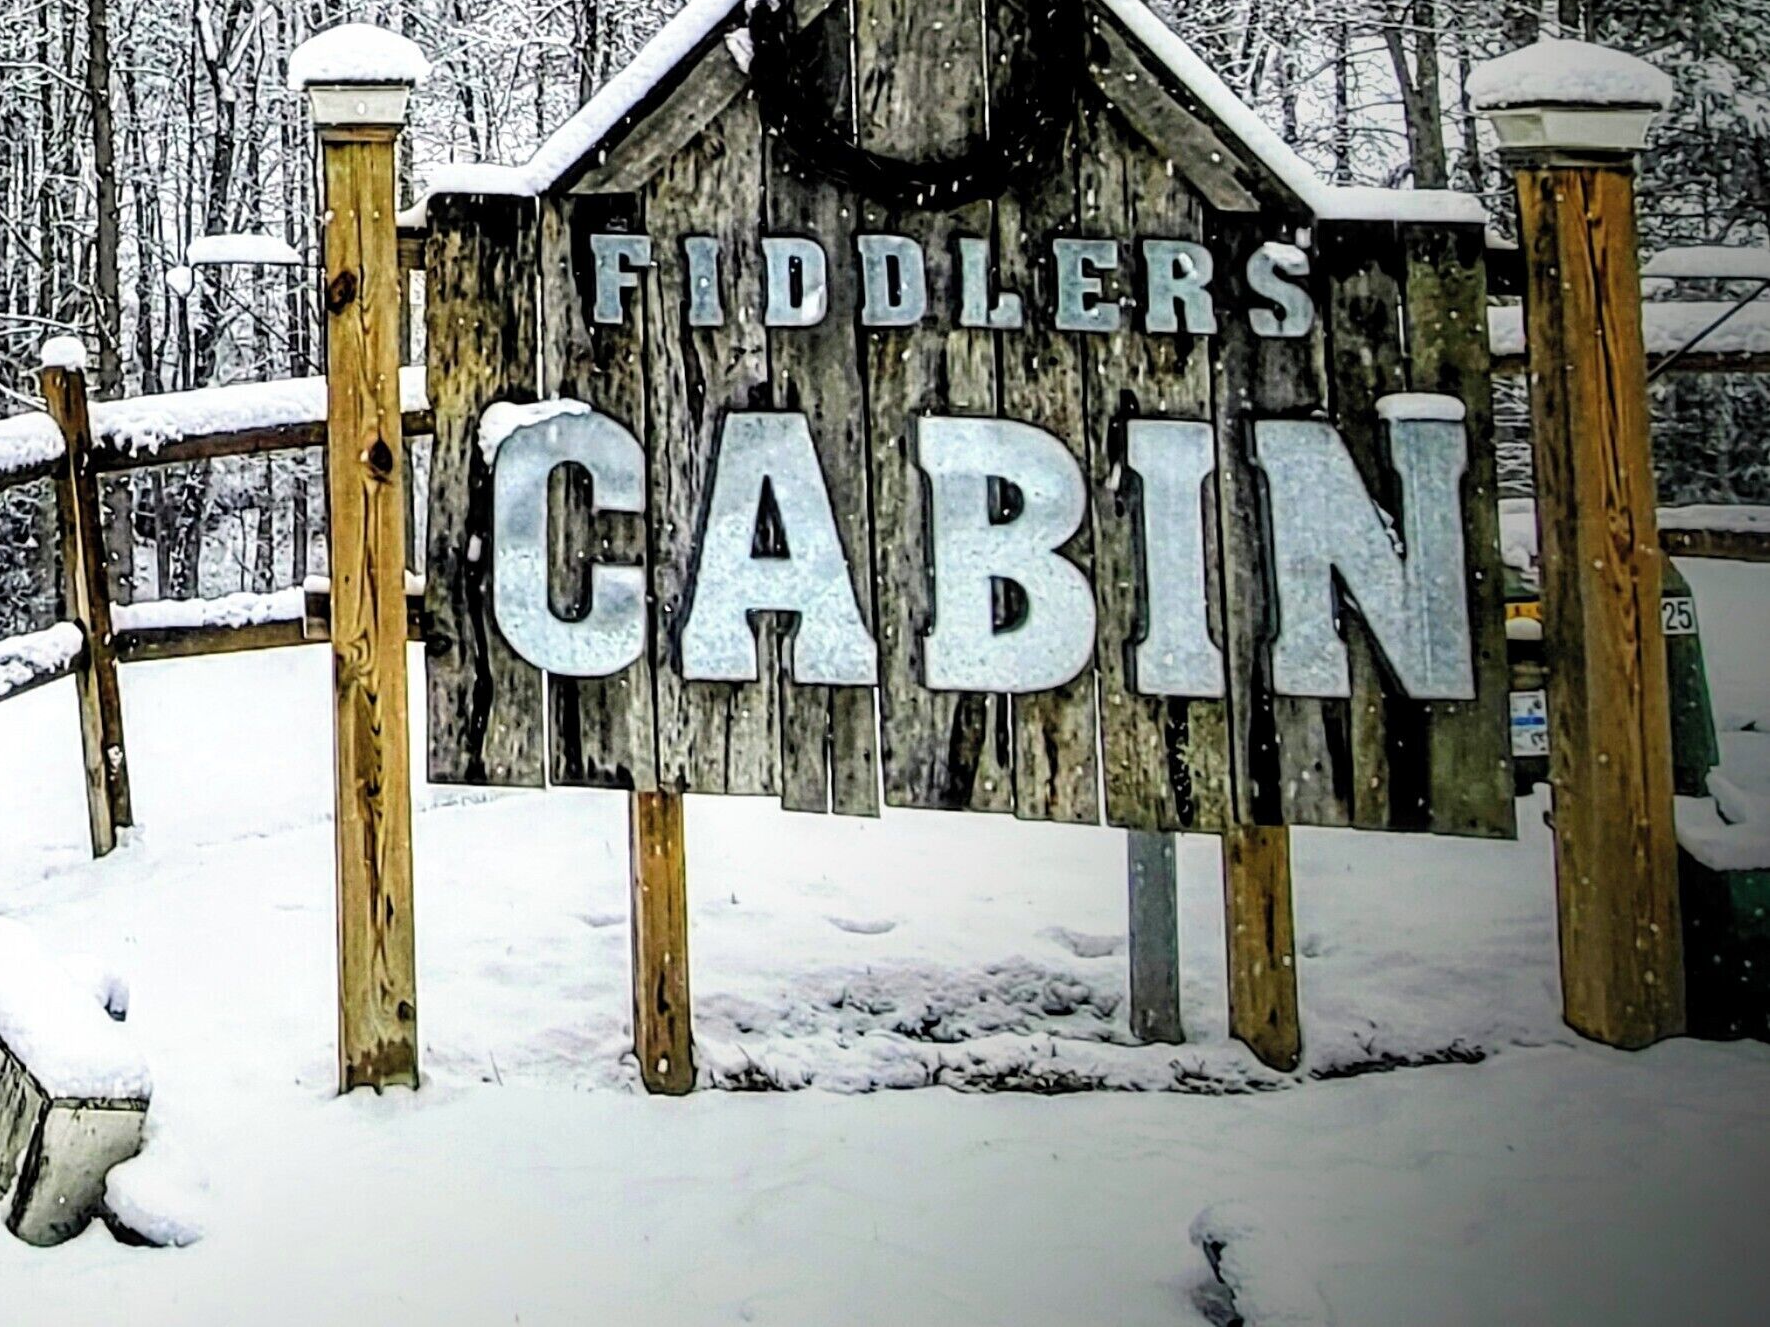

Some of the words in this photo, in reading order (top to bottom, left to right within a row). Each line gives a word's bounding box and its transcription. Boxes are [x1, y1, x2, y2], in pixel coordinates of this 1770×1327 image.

[590, 234, 1316, 338] FIDDLERS
[493, 408, 1477, 701] CABIN
[1662, 601, 1693, 631] 25
